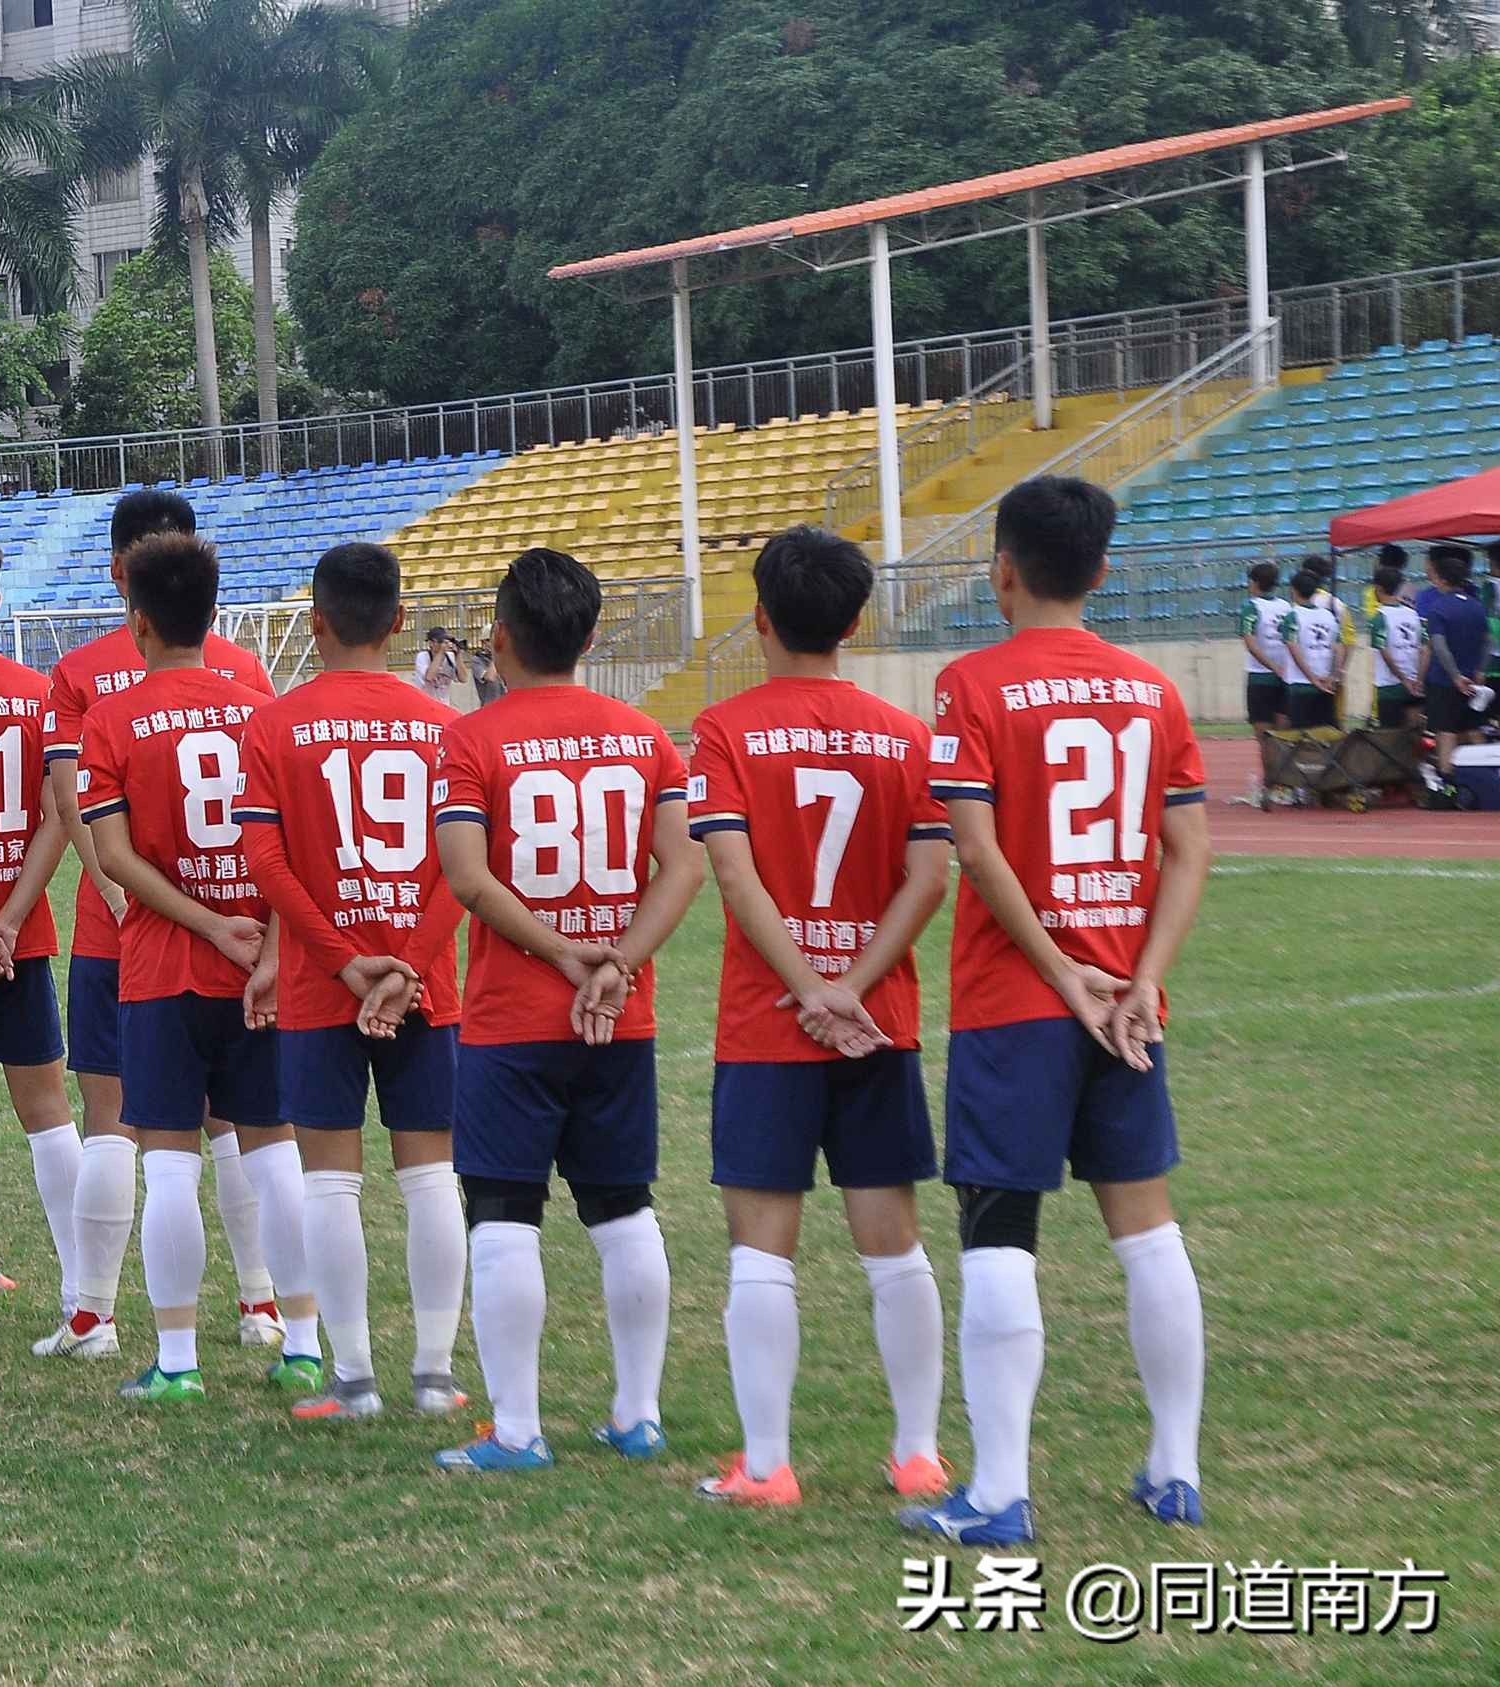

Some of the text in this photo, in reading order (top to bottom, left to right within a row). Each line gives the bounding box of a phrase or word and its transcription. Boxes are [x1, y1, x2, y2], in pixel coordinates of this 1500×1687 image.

[177, 731, 242, 849] 8
[292, 719, 445, 747] 冠雄河池生态餐厅
[502, 734, 656, 766] 冠雄河池生态餐厅
[744, 728, 911, 762] 冠雄河池生态餐厅
[1045, 717, 1151, 866] 21
[321, 748, 429, 873] 19
[510, 764, 646, 900] 80
[793, 766, 865, 908] 7
